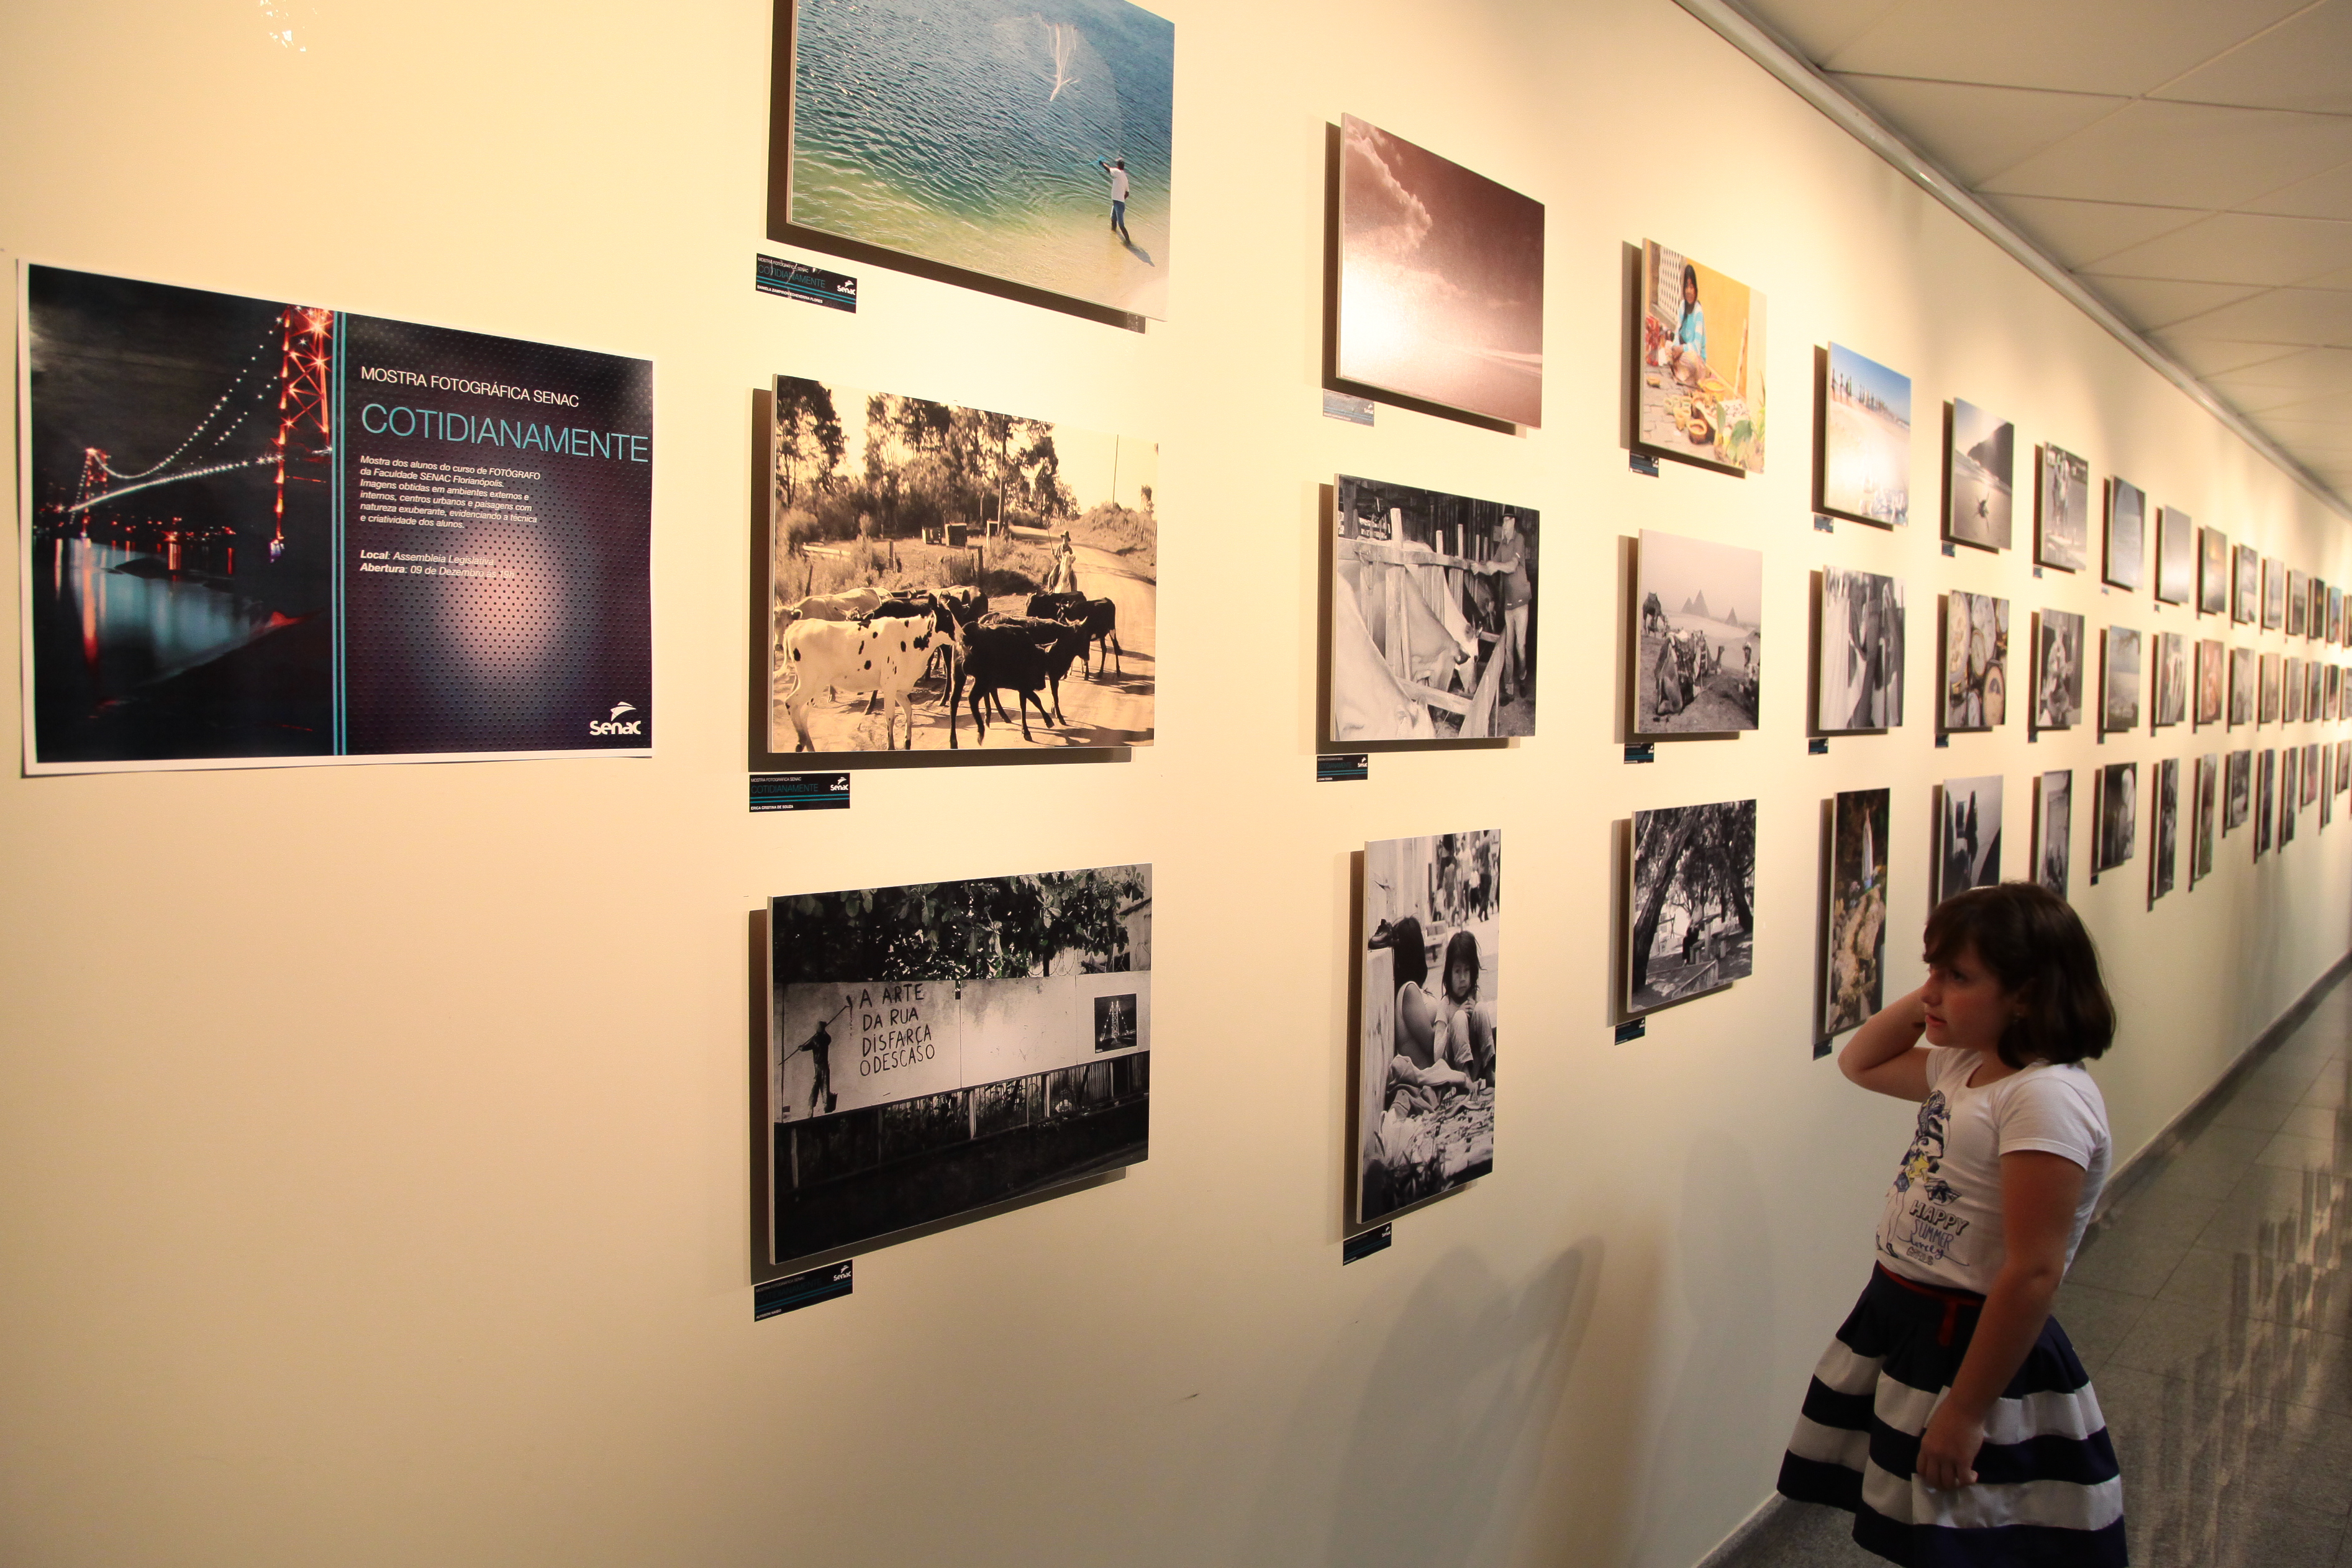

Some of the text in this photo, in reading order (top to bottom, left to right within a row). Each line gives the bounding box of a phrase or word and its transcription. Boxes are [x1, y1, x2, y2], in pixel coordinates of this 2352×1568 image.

[758, 265, 825, 288] COTIDIANAMENTE
[837, 285, 856, 296] Senac
[361, 366, 579, 407] MOSTRA FOTOGRÁFICA SENAC
[361, 403, 649, 463] COTIDIANAMENTE
[360, 455, 390, 466] Mostra
[392, 459, 408, 467] dos
[410, 461, 438, 470] alunos
[453, 466, 474, 474] curso
[489, 468, 540, 480] FOTÓGRAFO
[373, 468, 418, 479] Faculdade
[420, 472, 452, 483] SENAC
[453, 475, 504, 487] Florianópolis.
[360, 479, 397, 489] Imagens
[399, 483, 430, 492] obtidas
[447, 487, 488, 497] ambientes
[489, 491, 522, 501] externos
[360, 490, 397, 502] internos,
[399, 495, 431, 504] centros
[433, 497, 466, 506] urbanos
[474, 501, 514, 511] paisagens
[360, 503, 397, 512] natureza
[399, 506, 447, 517] exuberante,
[449, 510, 502, 520] evidenciando
[511, 514, 538, 523] técnica
[368, 515, 417, 525] criatividade
[419, 518, 434, 526] dos
[436, 520, 465, 528] alunos.
[360, 550, 494, 566] Local: Assembleia Legislativa
[360, 563, 515, 579] Abertura: 09 de Dezembro às 19h
[589, 720, 641, 735] Senac
[751, 784, 819, 794] COTIDIANAMENTE
[860, 984, 924, 1009] A ARTE
[863, 1007, 919, 1031] DA RUA
[1909, 1200, 1969, 1236] HAPPY
[1911, 1218, 1954, 1251] SUMMER
[833, 1271, 851, 1281] Senac
